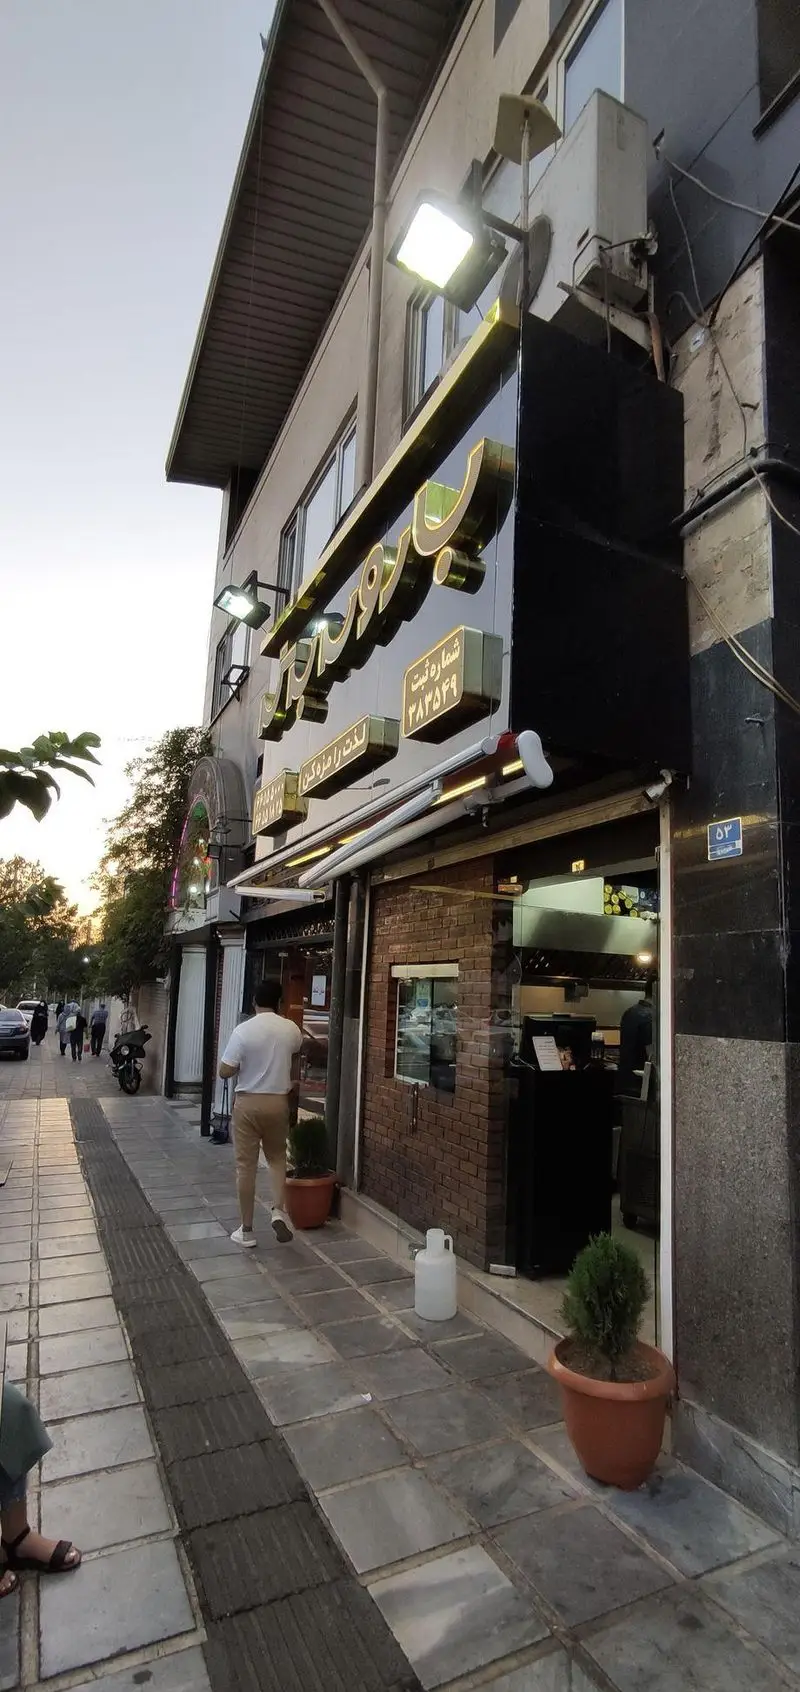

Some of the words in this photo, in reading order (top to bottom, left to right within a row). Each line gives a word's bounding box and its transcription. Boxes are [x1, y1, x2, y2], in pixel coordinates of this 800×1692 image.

[430, 637, 461, 682] شماره
[411, 658, 430, 693] ثبت
[408, 673, 458, 728] ۳۸۳۵۴۹
[343, 722, 367, 757] لذت
[317, 755, 332, 779] مزه
[333, 746, 342, 768] را
[303, 765, 315, 787] کن
[715, 824, 732, 840] ۵۳
